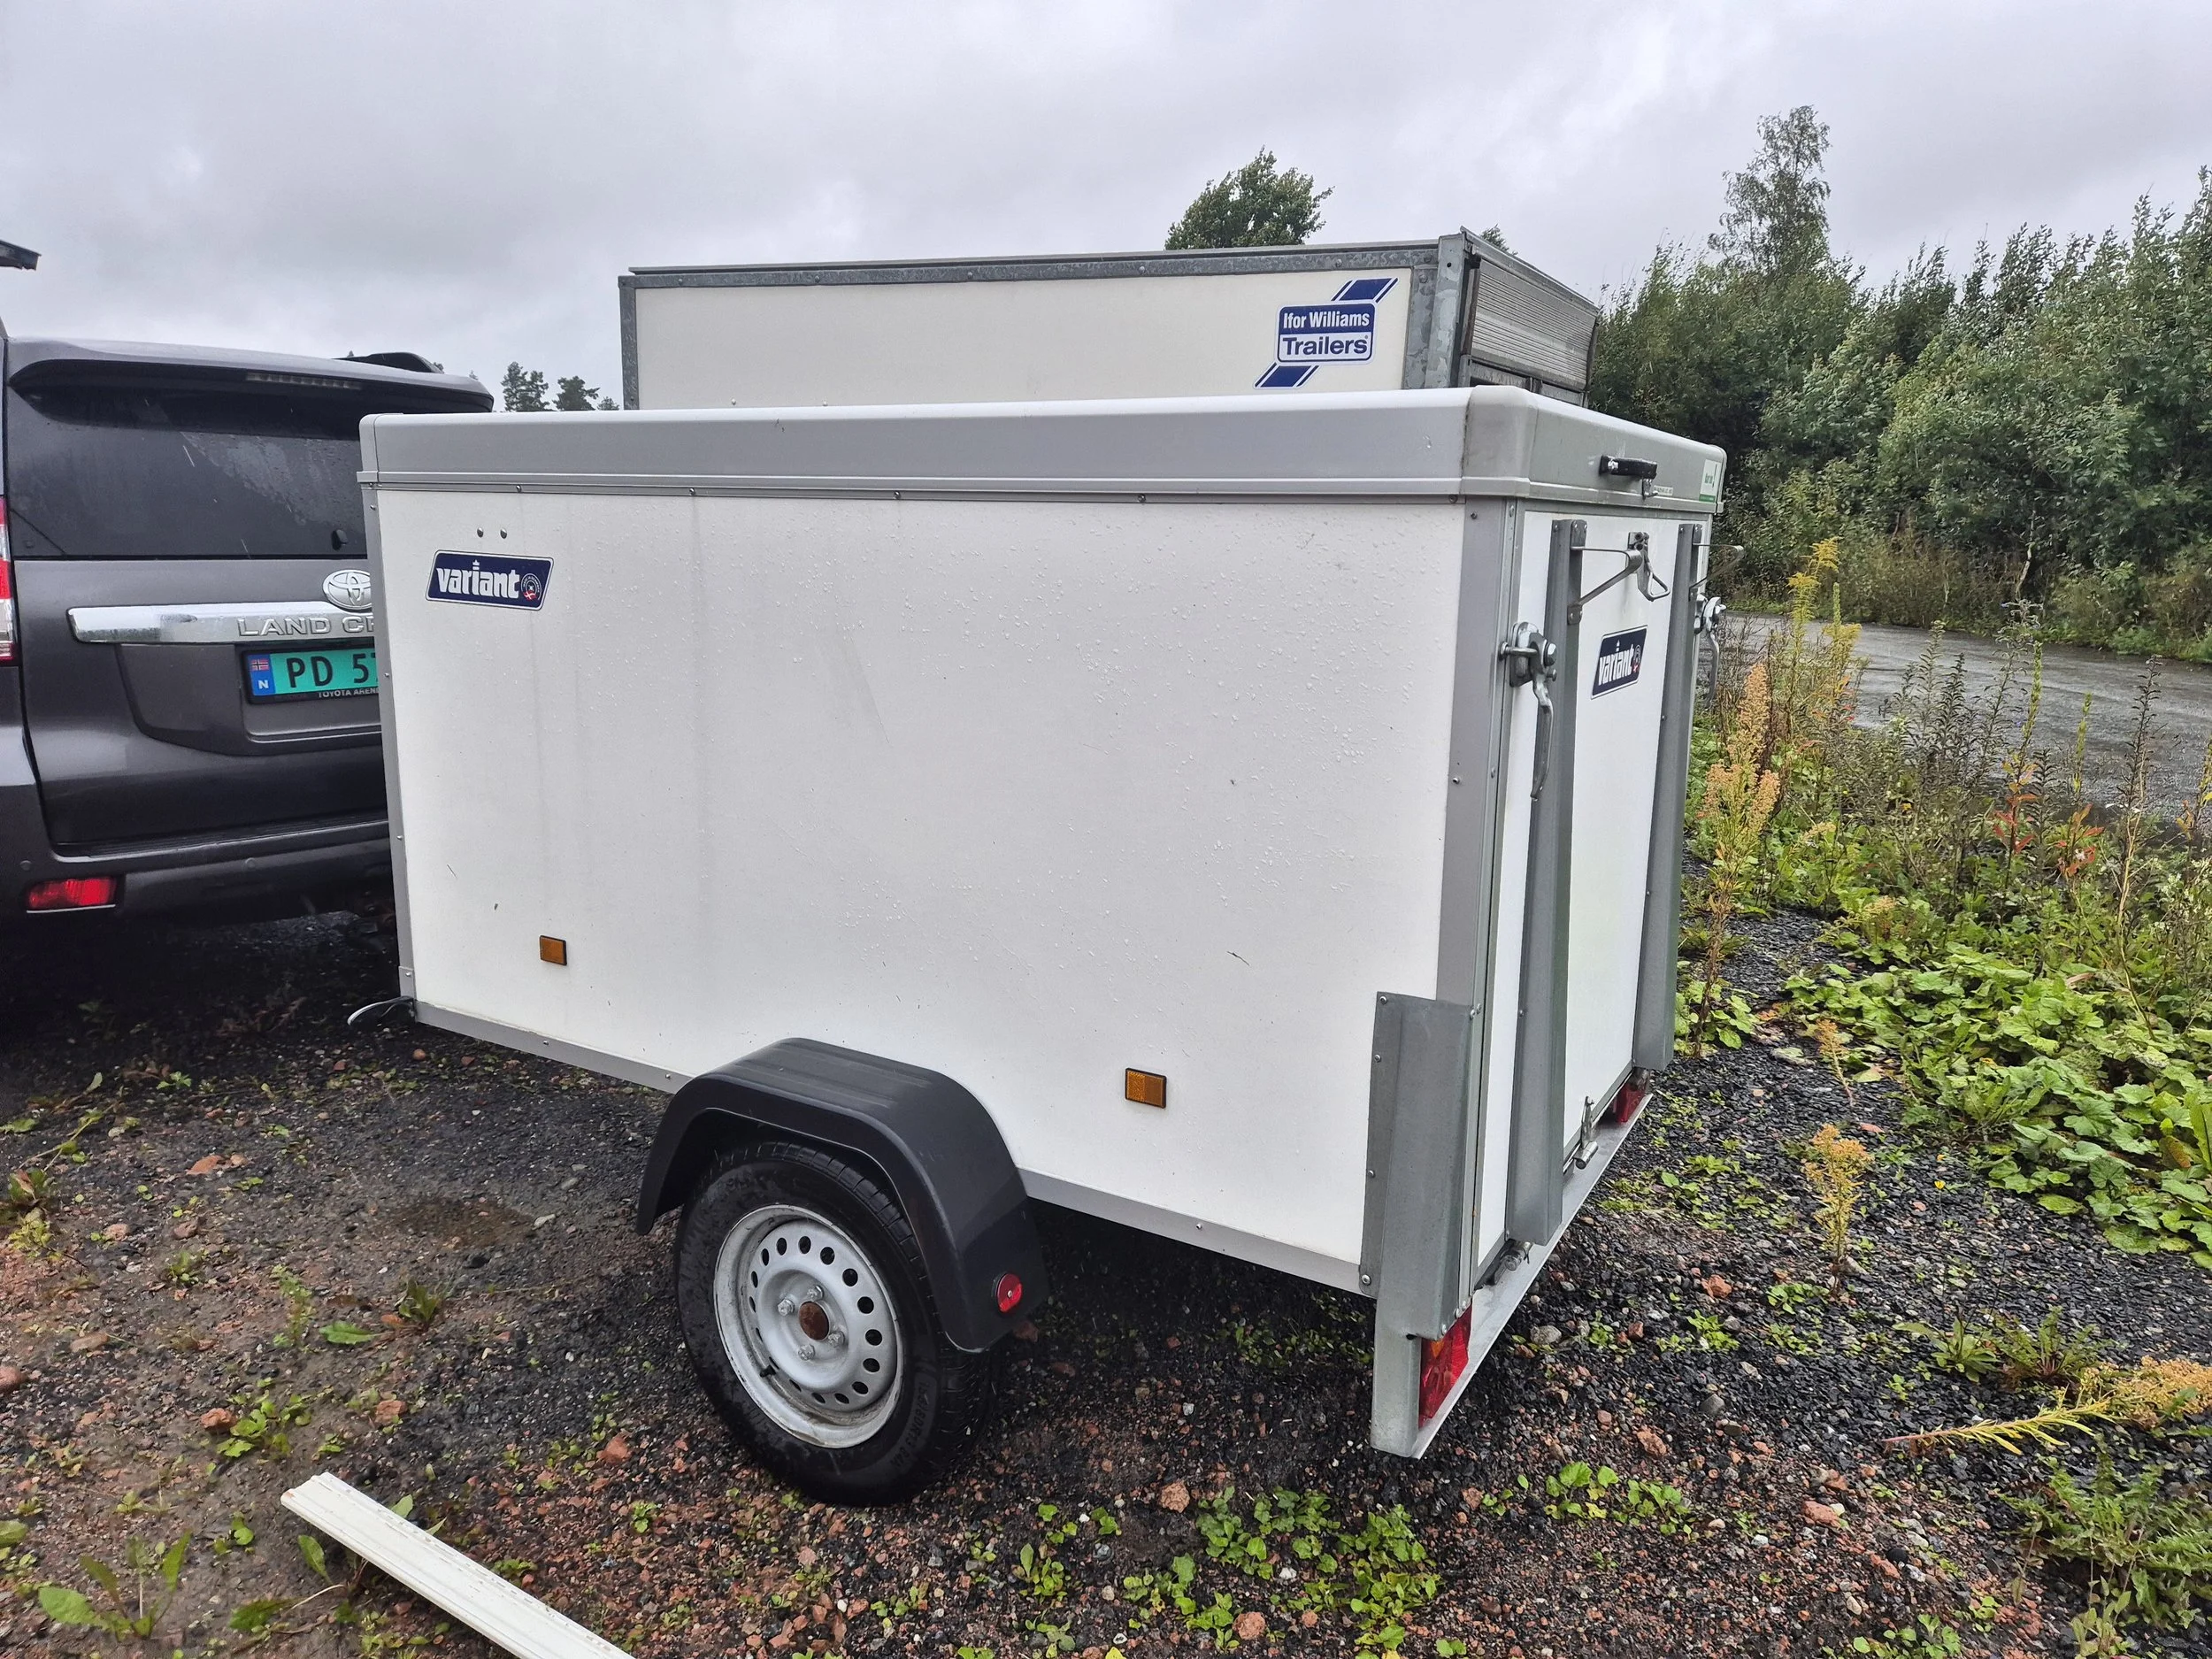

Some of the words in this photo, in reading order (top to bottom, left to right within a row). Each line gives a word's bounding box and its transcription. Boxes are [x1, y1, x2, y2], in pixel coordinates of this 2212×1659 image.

[1284, 312, 1307, 328] Ifor
[1310, 311, 1370, 327] Williams
[1282, 336, 1368, 356] Trailers
[436, 562, 520, 599] variant
[237, 617, 332, 636] LAND
[286, 657, 334, 688] PD
[353, 653, 379, 683] 5
[1598, 642, 1634, 686] variant
[257, 680, 269, 689] N
[319, 689, 352, 698] TOYOTA
